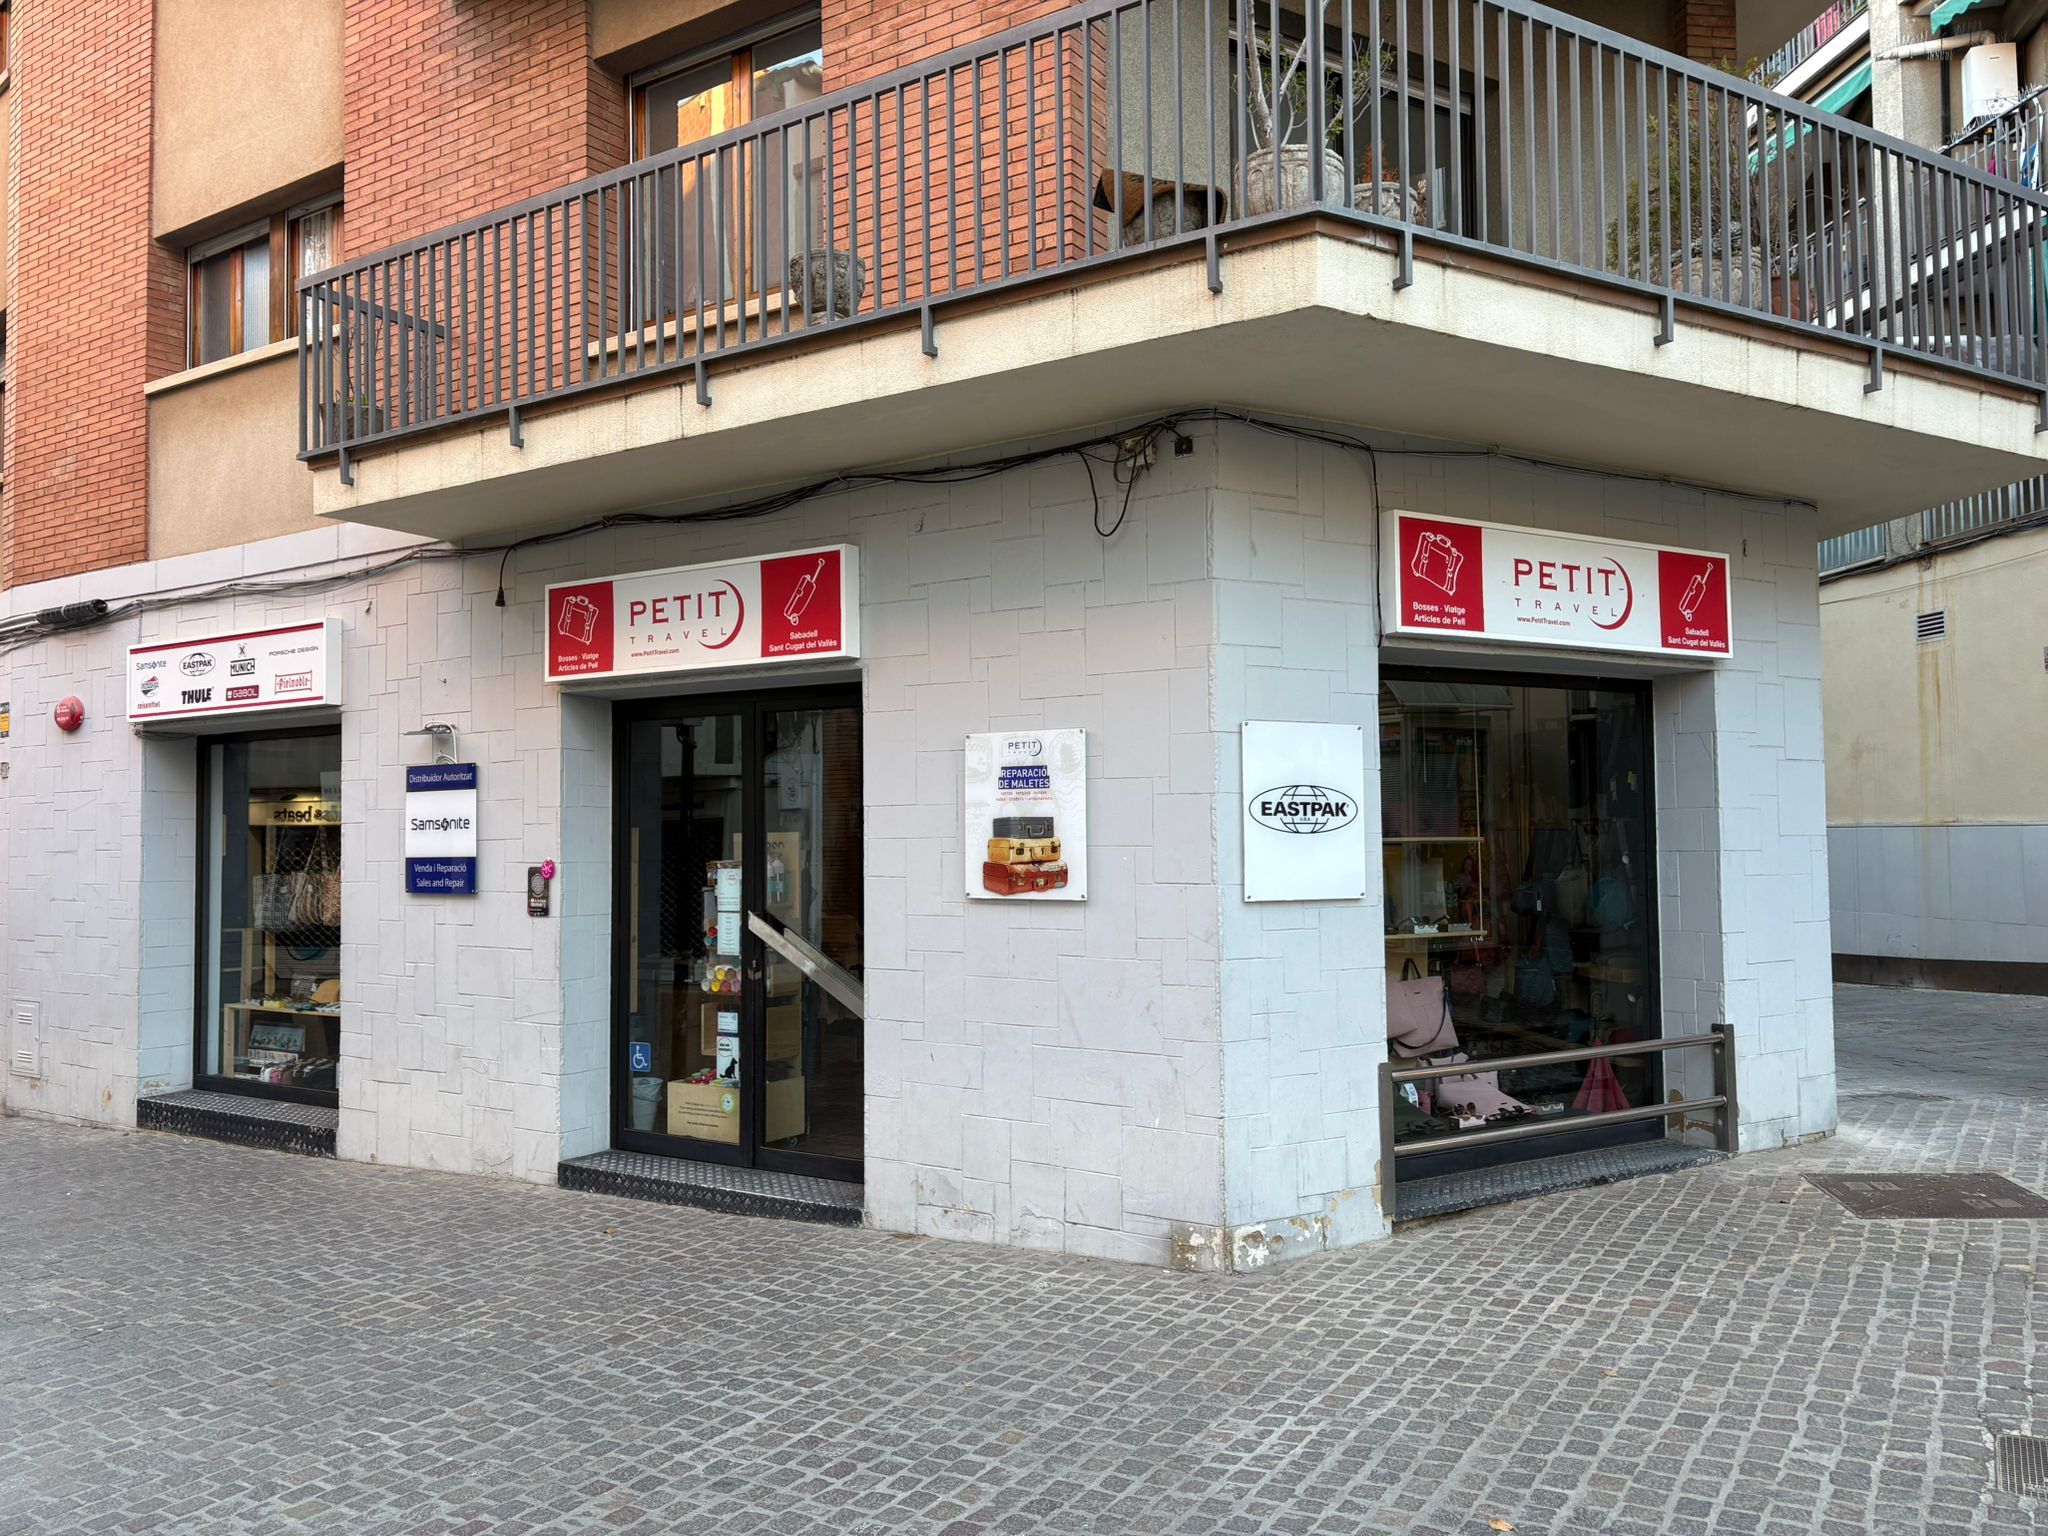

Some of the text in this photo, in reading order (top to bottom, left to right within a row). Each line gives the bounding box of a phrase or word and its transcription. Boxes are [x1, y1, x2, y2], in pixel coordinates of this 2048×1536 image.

[1513, 558, 1616, 596] PETIT
[629, 589, 727, 626] PETIT
[1412, 601, 1466, 615] Bosses Viatge
[1514, 597, 1617, 617] TRAVEL
[1413, 613, 1466, 626] Articles de Pell
[1516, 615, 1571, 627] www.PetitTravel.com
[630, 627, 727, 645] TRAVEL
[789, 629, 818, 640] Sabadell
[1685, 626, 1710, 636] Sabadell
[768, 644, 784, 653] Sant
[784, 641, 806, 652] Cugat
[805, 640, 817, 649] del
[1667, 635, 1682, 644] Sant
[1681, 637, 1699, 647] Cugat
[1700, 639, 1709, 647] del
[268, 645, 319, 657] PORSCHE DESIGN
[630, 647, 681, 658] www.PetitTravel.com
[558, 652, 600, 663] Bosses Viatge
[135, 660, 167, 671] Samsonite
[183, 660, 212, 670] EASTPAK
[230, 662, 256, 673] MUNICH
[558, 661, 599, 672] Articles de Pell
[181, 687, 212, 705] THULE
[1008, 741, 1037, 749] PETIT
[1001, 766, 1047, 778] REPARACIÓ
[998, 778, 1050, 788] DE MALETES
[1261, 801, 1347, 817] EASTPAK
[411, 818, 470, 831] Samsonite
[413, 863, 433, 873] Venda
[436, 863, 467, 874] Reparació
[416, 878, 465, 889] Sales and Repair
